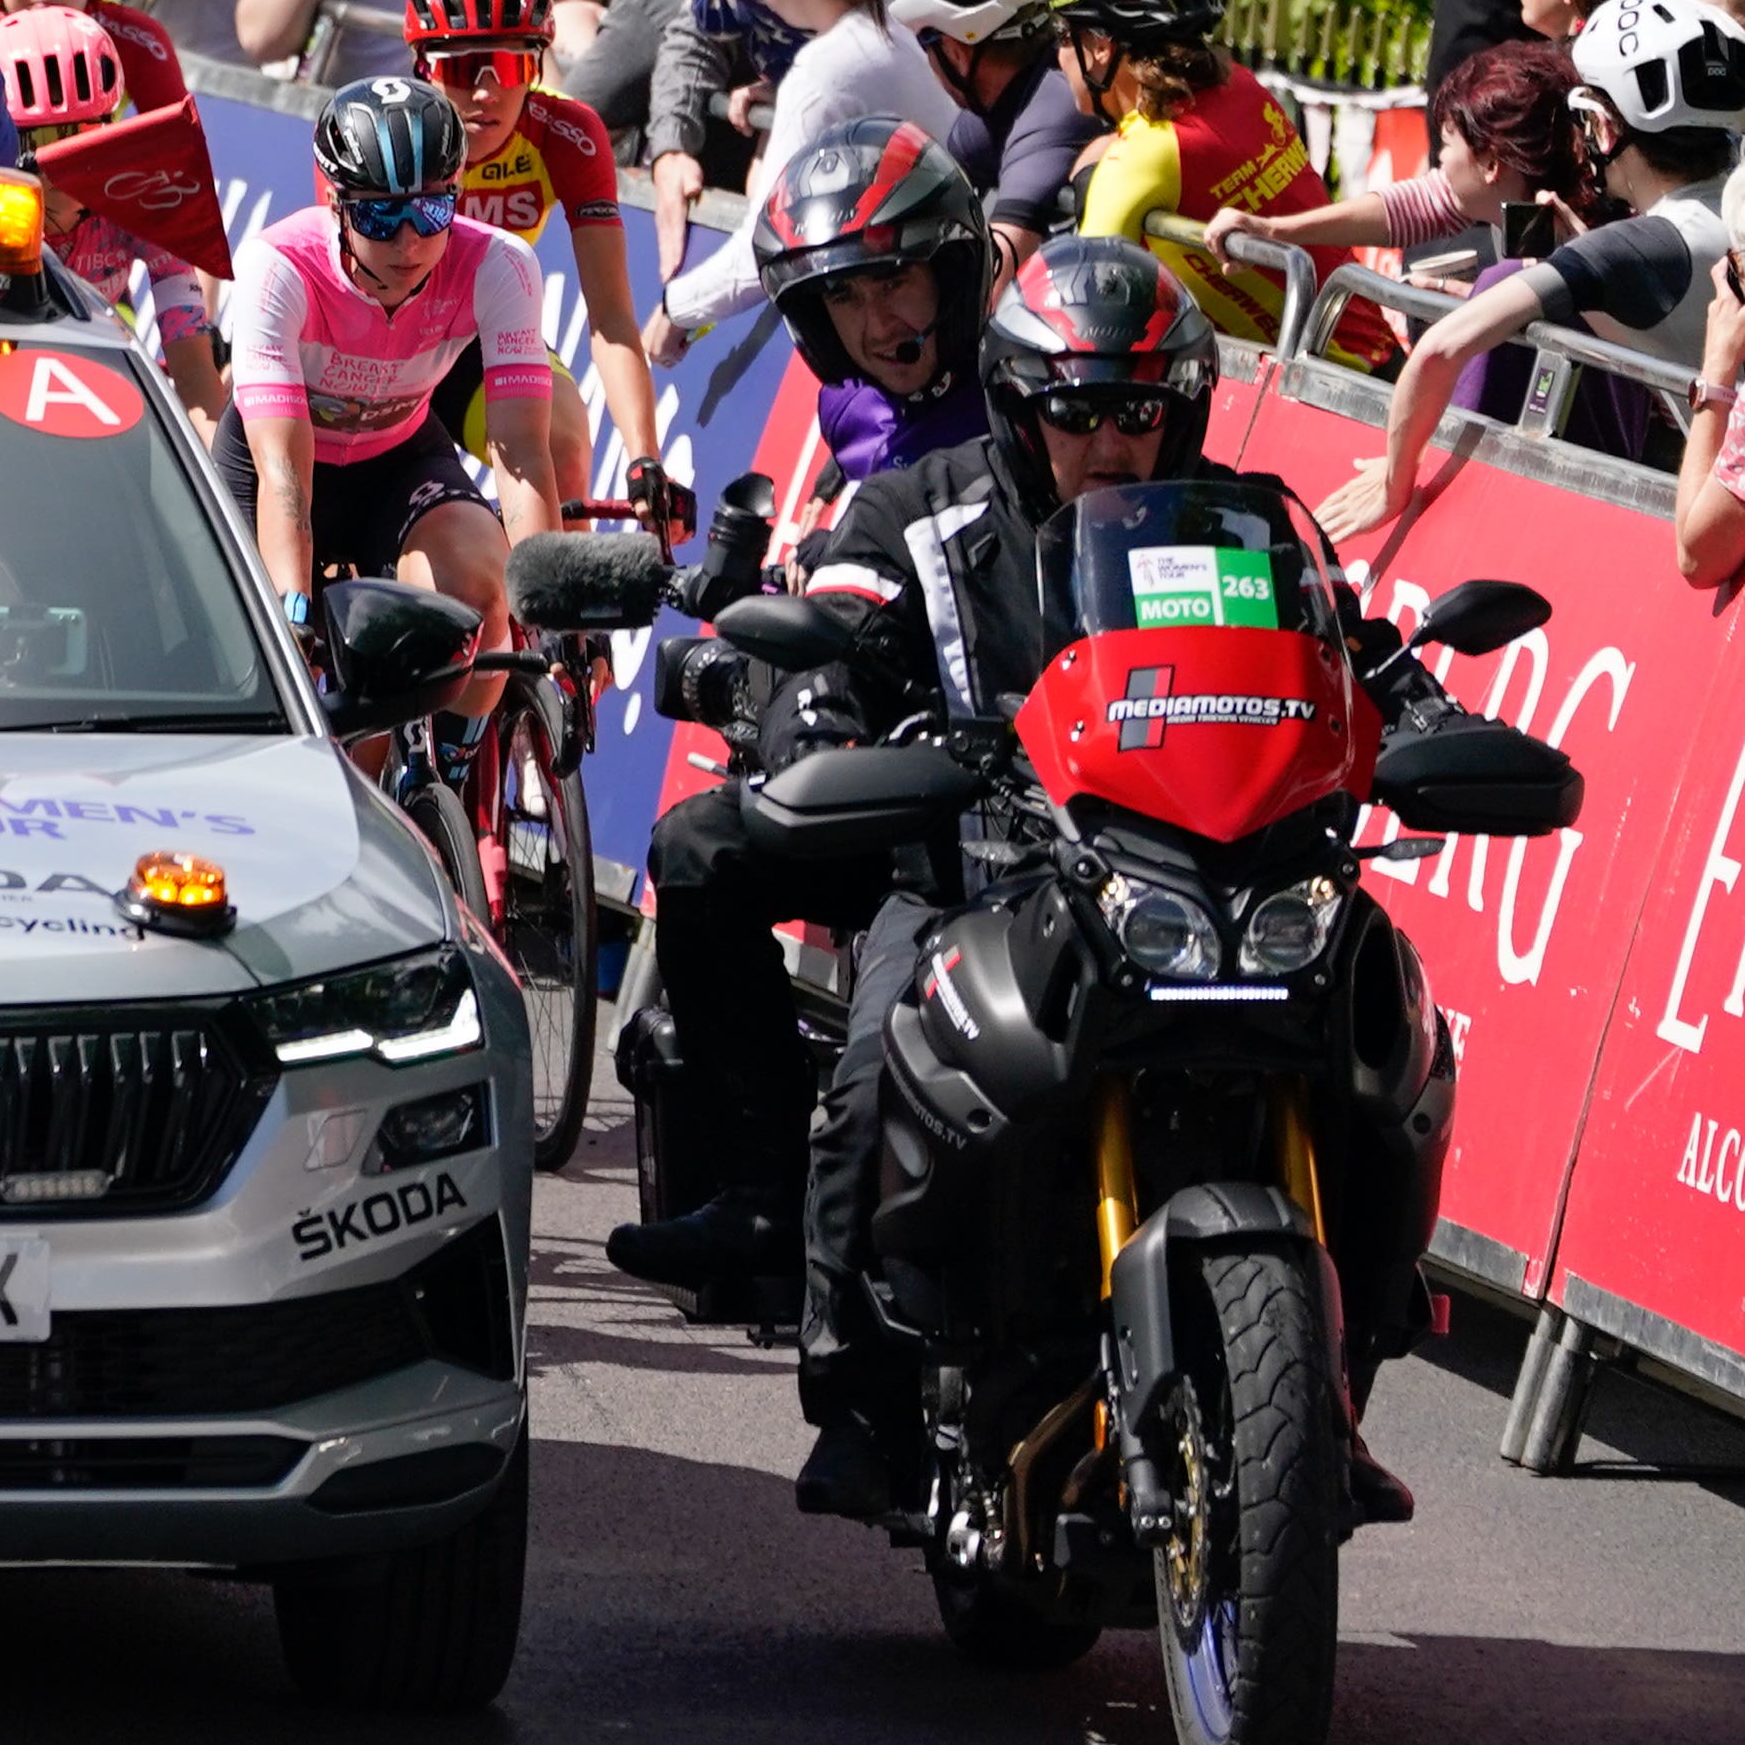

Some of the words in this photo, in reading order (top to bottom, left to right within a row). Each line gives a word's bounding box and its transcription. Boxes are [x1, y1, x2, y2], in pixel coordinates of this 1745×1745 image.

[527, 100, 599, 157] BASSO
[1209, 160, 1258, 200] TEAM
[1219, 133, 1310, 217] CHERWE
[465, 189, 541, 230] MS
[496, 327, 539, 341] BREAST
[497, 335, 537, 347] CANCER
[497, 345, 523, 356] NOW
[324, 365, 403, 387] CANCER
[329, 352, 404, 376] BREAST
[24, 357, 112, 428] A
[319, 376, 369, 397] NOW
[1157, 556, 1176, 566] THE
[1158, 563, 1208, 573] WOMEN'S
[1158, 570, 1186, 580] TOUR
[1221, 575, 1272, 601] 263
[1140, 597, 1210, 621] MOTO
[1107, 694, 1317, 723] MEDIAMOTOS.TV
[292, 1170, 469, 1264] ŠKODA
